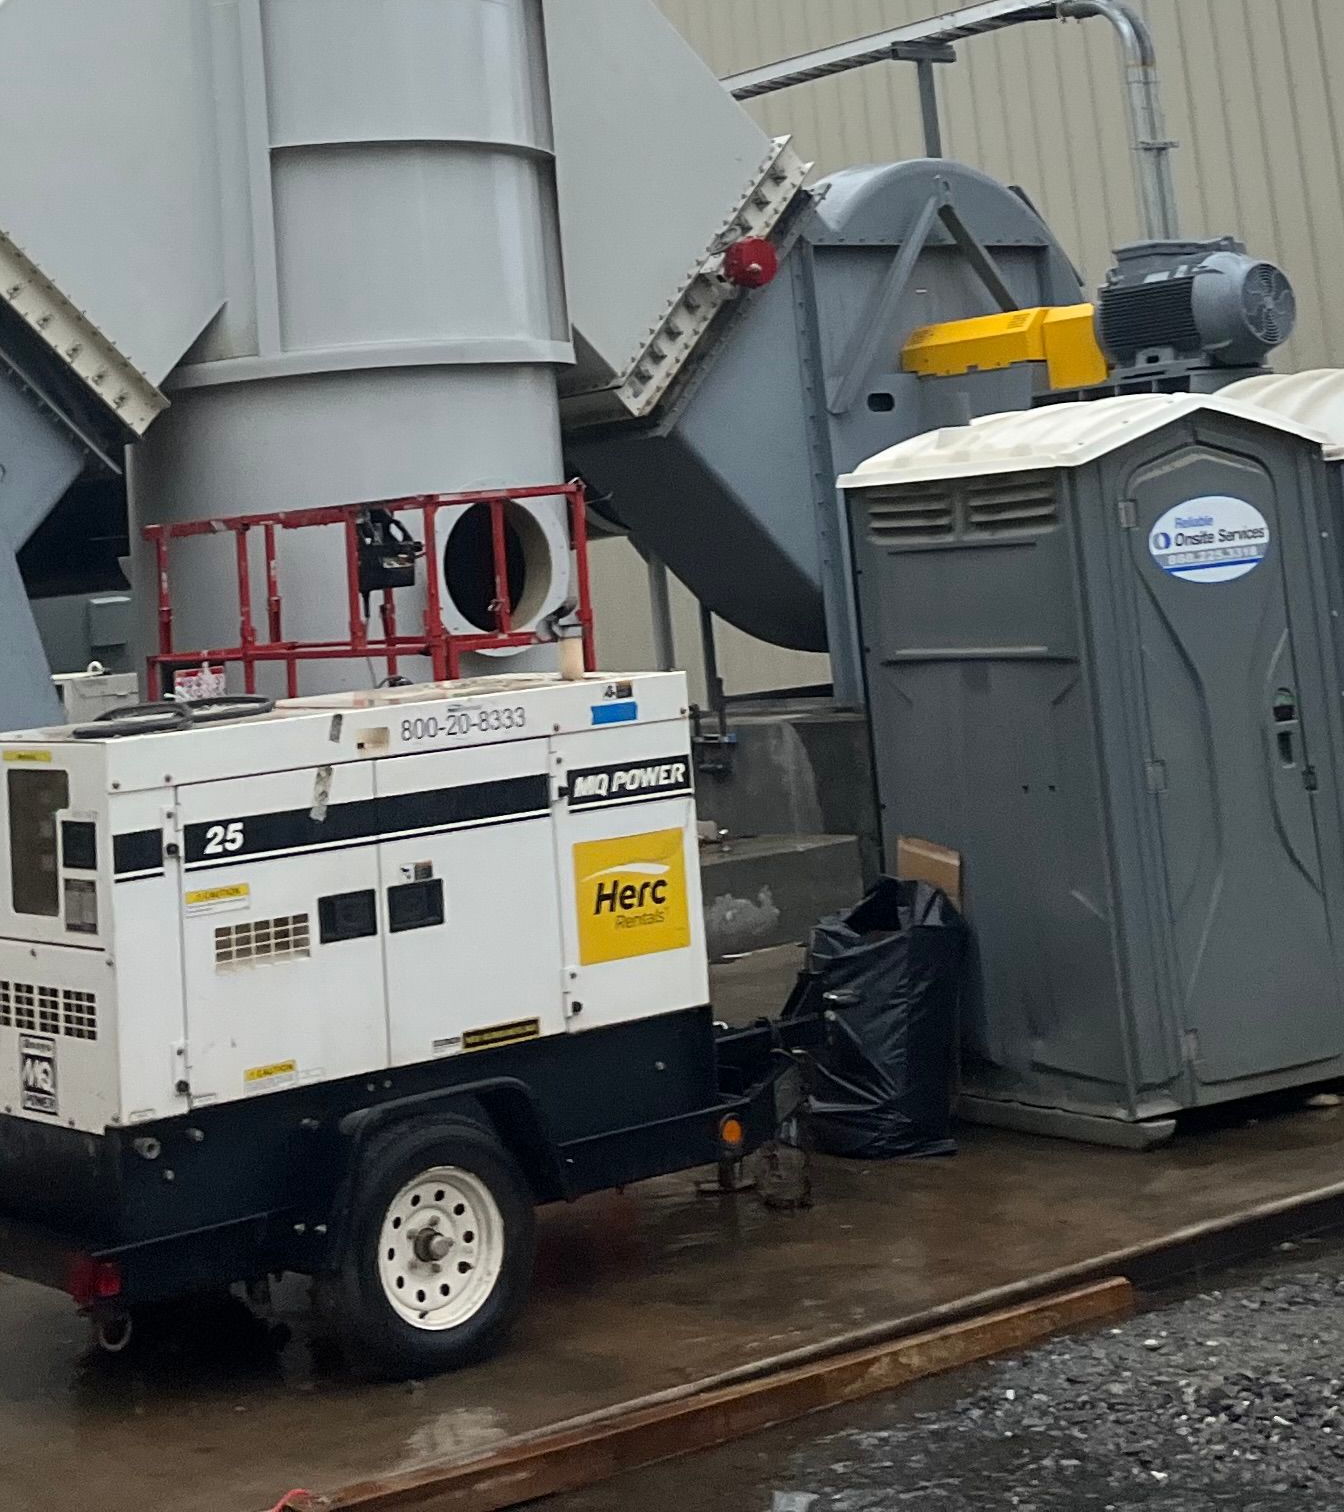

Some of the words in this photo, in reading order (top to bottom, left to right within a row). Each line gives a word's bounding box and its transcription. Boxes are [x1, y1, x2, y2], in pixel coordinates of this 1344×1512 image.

[1175, 531, 1215, 547] Onsite
[1218, 526, 1265, 543] Services
[401, 706, 526, 742] 800-20-8333
[573, 774, 609, 799] MQ
[611, 763, 685, 793] POWER
[203, 822, 245, 855] 25
[593, 879, 669, 916] Herc
[22, 1056, 55, 1094] MQ
